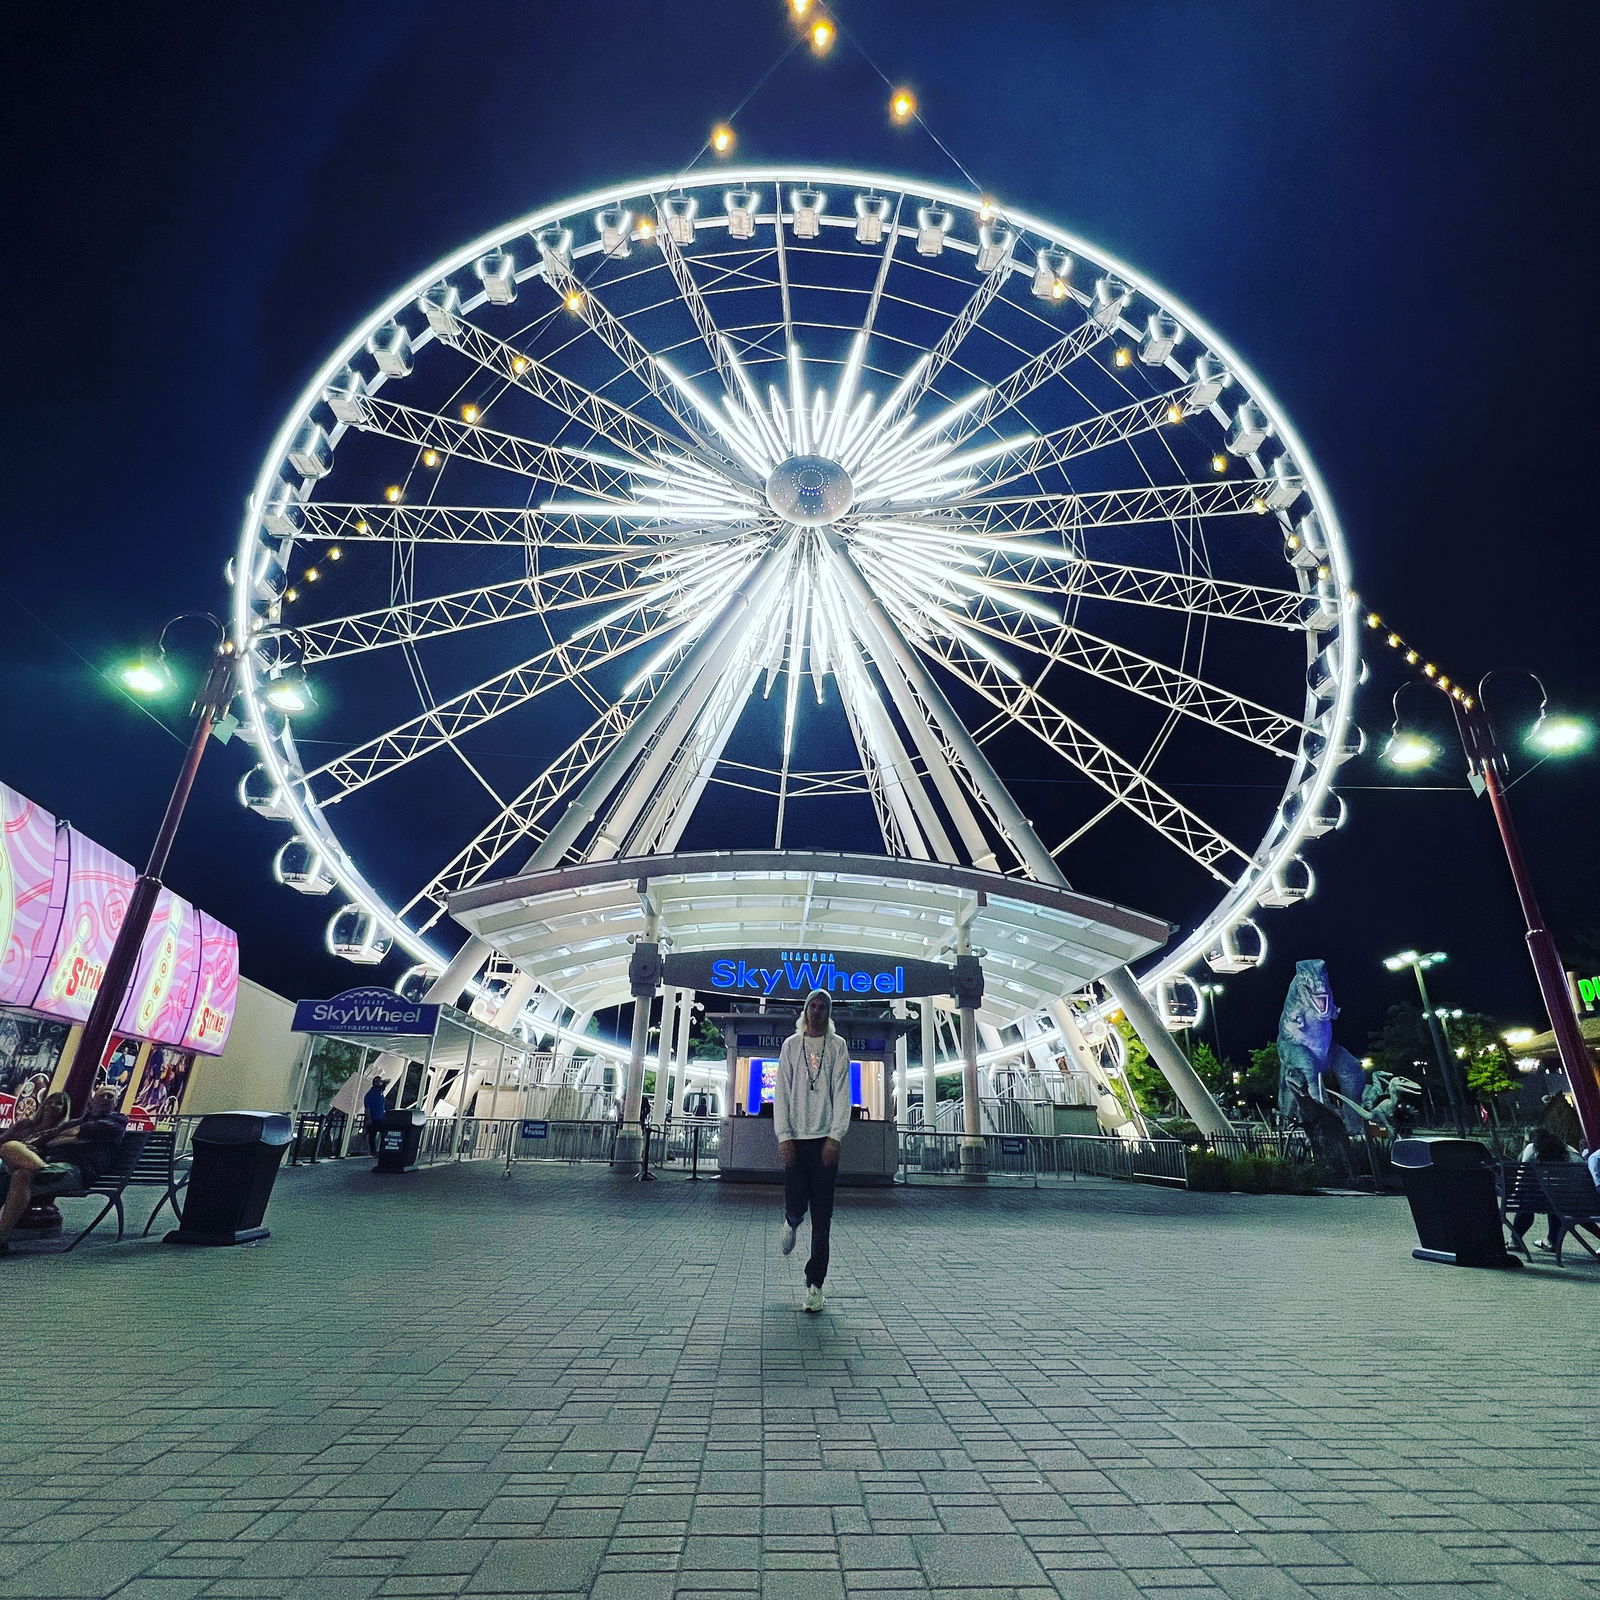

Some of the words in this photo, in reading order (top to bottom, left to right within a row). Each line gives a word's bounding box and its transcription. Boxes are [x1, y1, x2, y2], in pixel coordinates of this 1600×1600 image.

[781, 952, 835, 962] NIAGARA
[65, 956, 104, 997] Strik
[711, 959, 905, 995] SkyWheel
[313, 1004, 422, 1025] SkyWheel
[758, 1035, 785, 1047] TICKET
[847, 1038, 866, 1050] KETS
